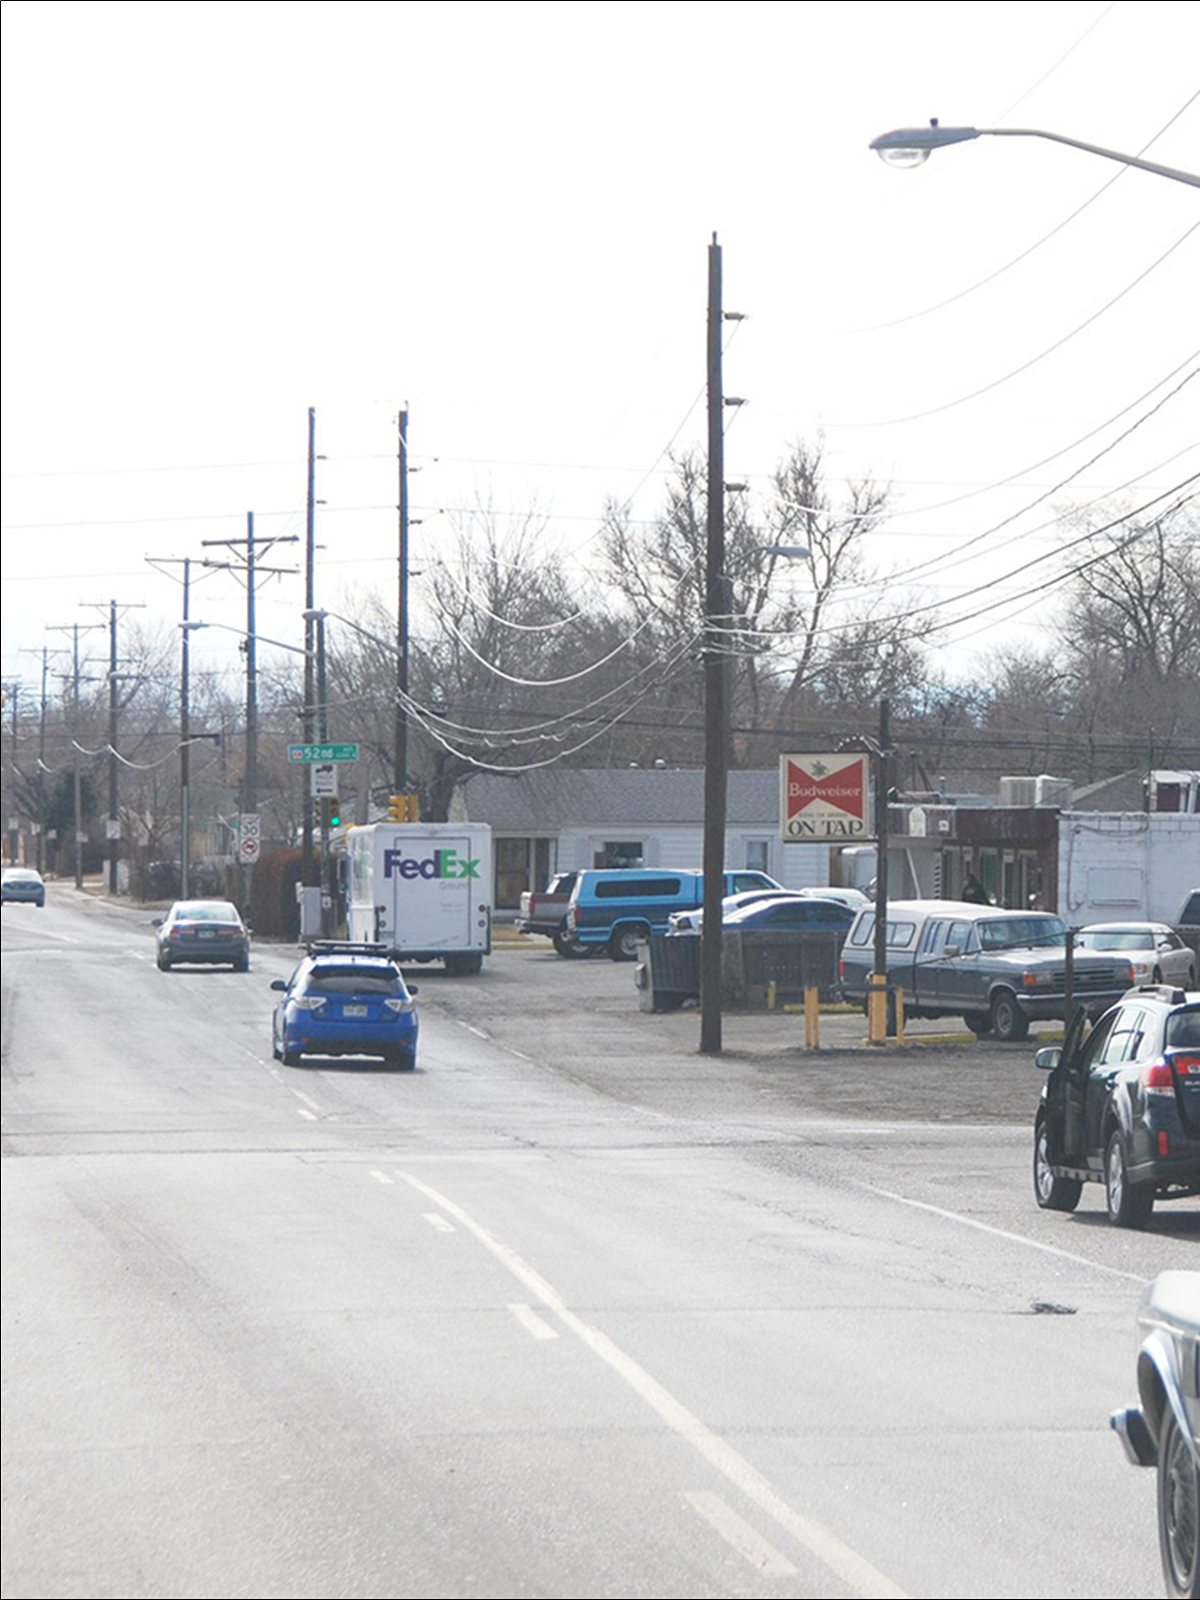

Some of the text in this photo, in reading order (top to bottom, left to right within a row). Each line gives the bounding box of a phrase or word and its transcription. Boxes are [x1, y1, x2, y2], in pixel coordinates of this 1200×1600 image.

[789, 782, 862, 797] Budweiser
[241, 825, 259, 836] 30
[788, 820, 863, 836] ON TAP
[384, 849, 482, 880] FedEx
